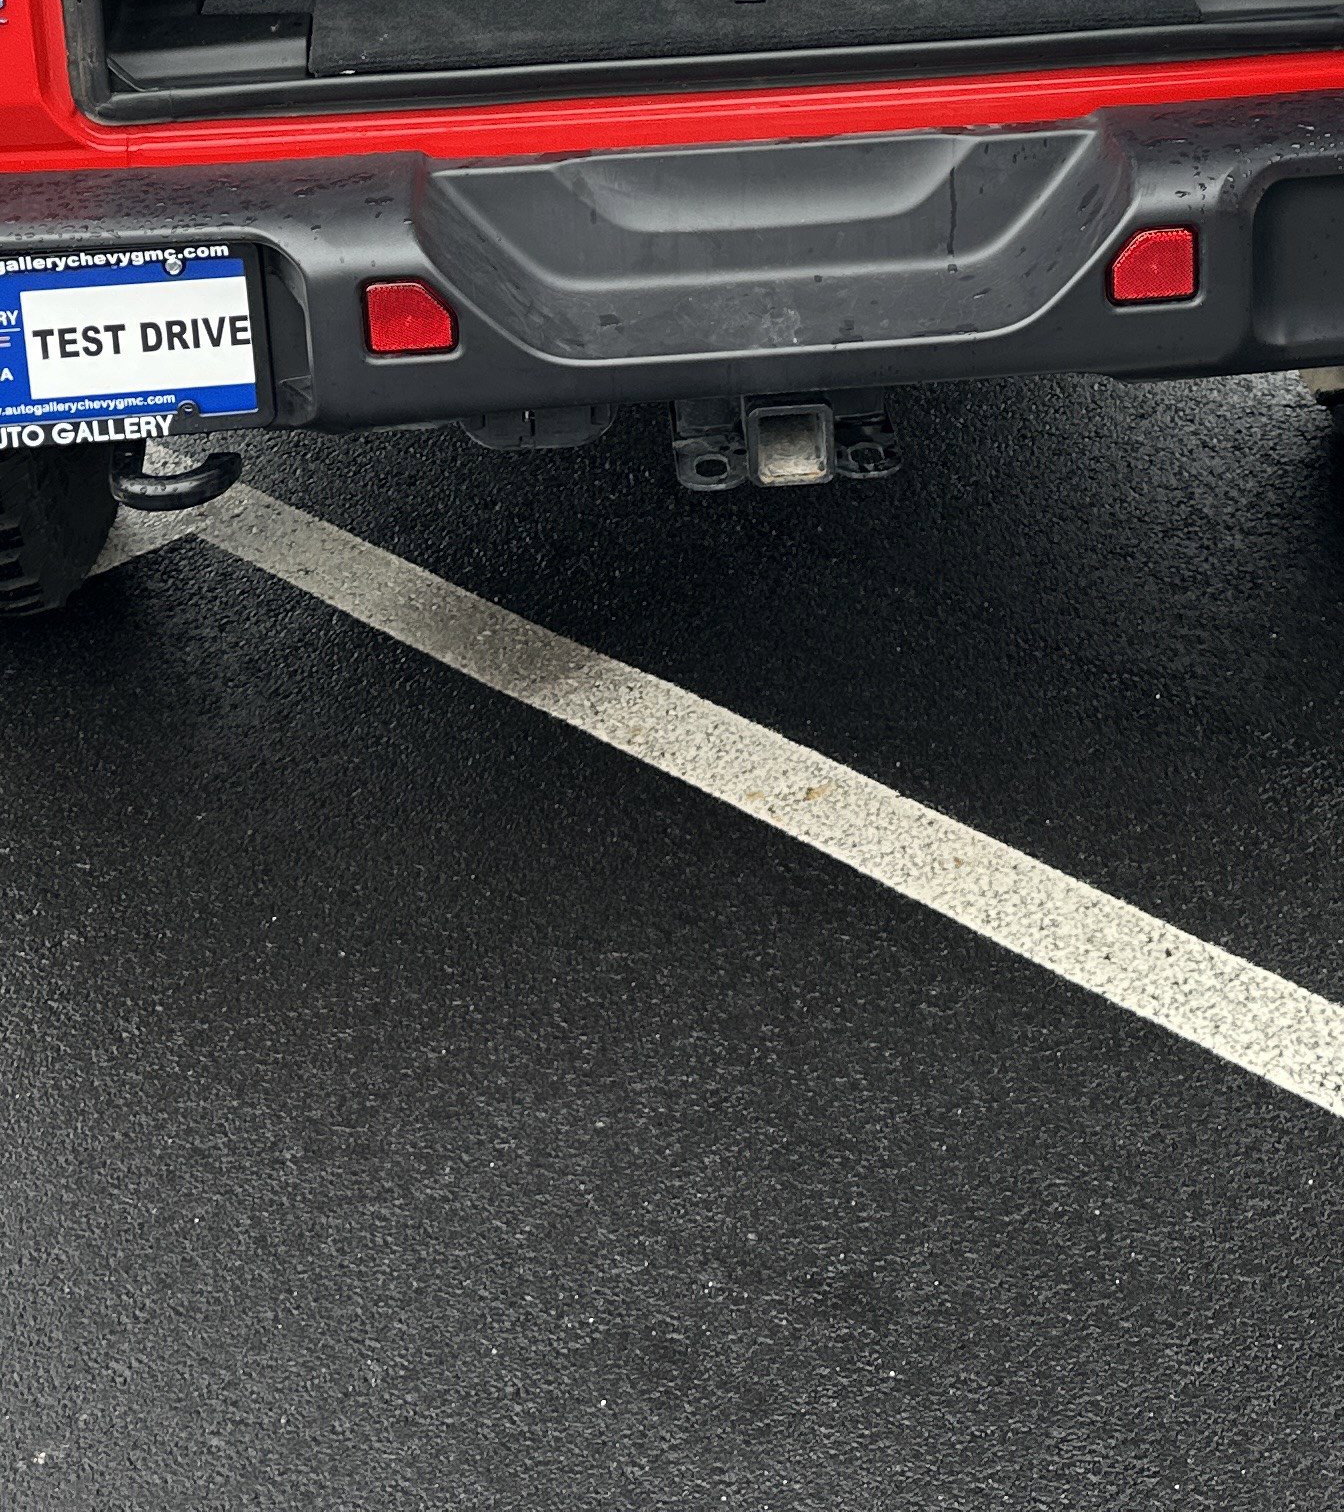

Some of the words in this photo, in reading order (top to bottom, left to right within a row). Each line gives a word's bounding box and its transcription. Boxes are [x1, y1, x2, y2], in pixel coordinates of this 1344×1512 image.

[33, 324, 126, 360] TEST
[141, 315, 251, 352] DRIVE
[52, 415, 173, 445] GALLERY
